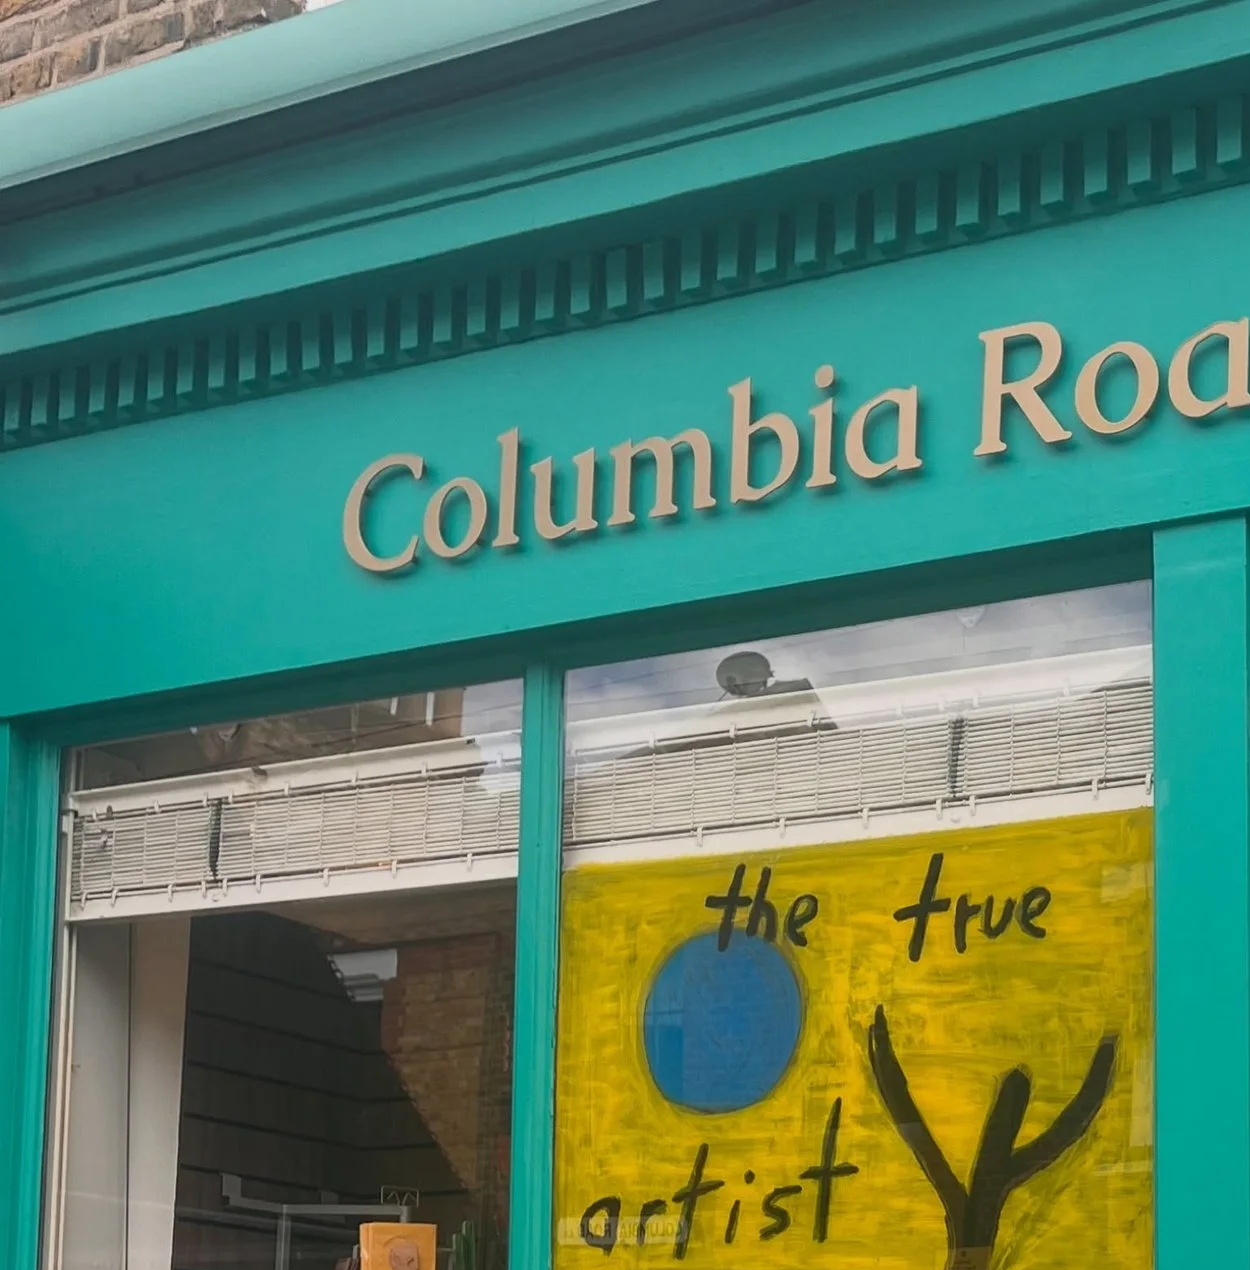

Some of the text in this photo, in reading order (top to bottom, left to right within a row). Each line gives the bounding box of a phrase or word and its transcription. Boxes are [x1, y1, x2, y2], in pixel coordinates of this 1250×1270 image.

[342, 364, 923, 574] Columbia
[705, 852, 1051, 962] the true
[580, 1097, 859, 1260] artist
